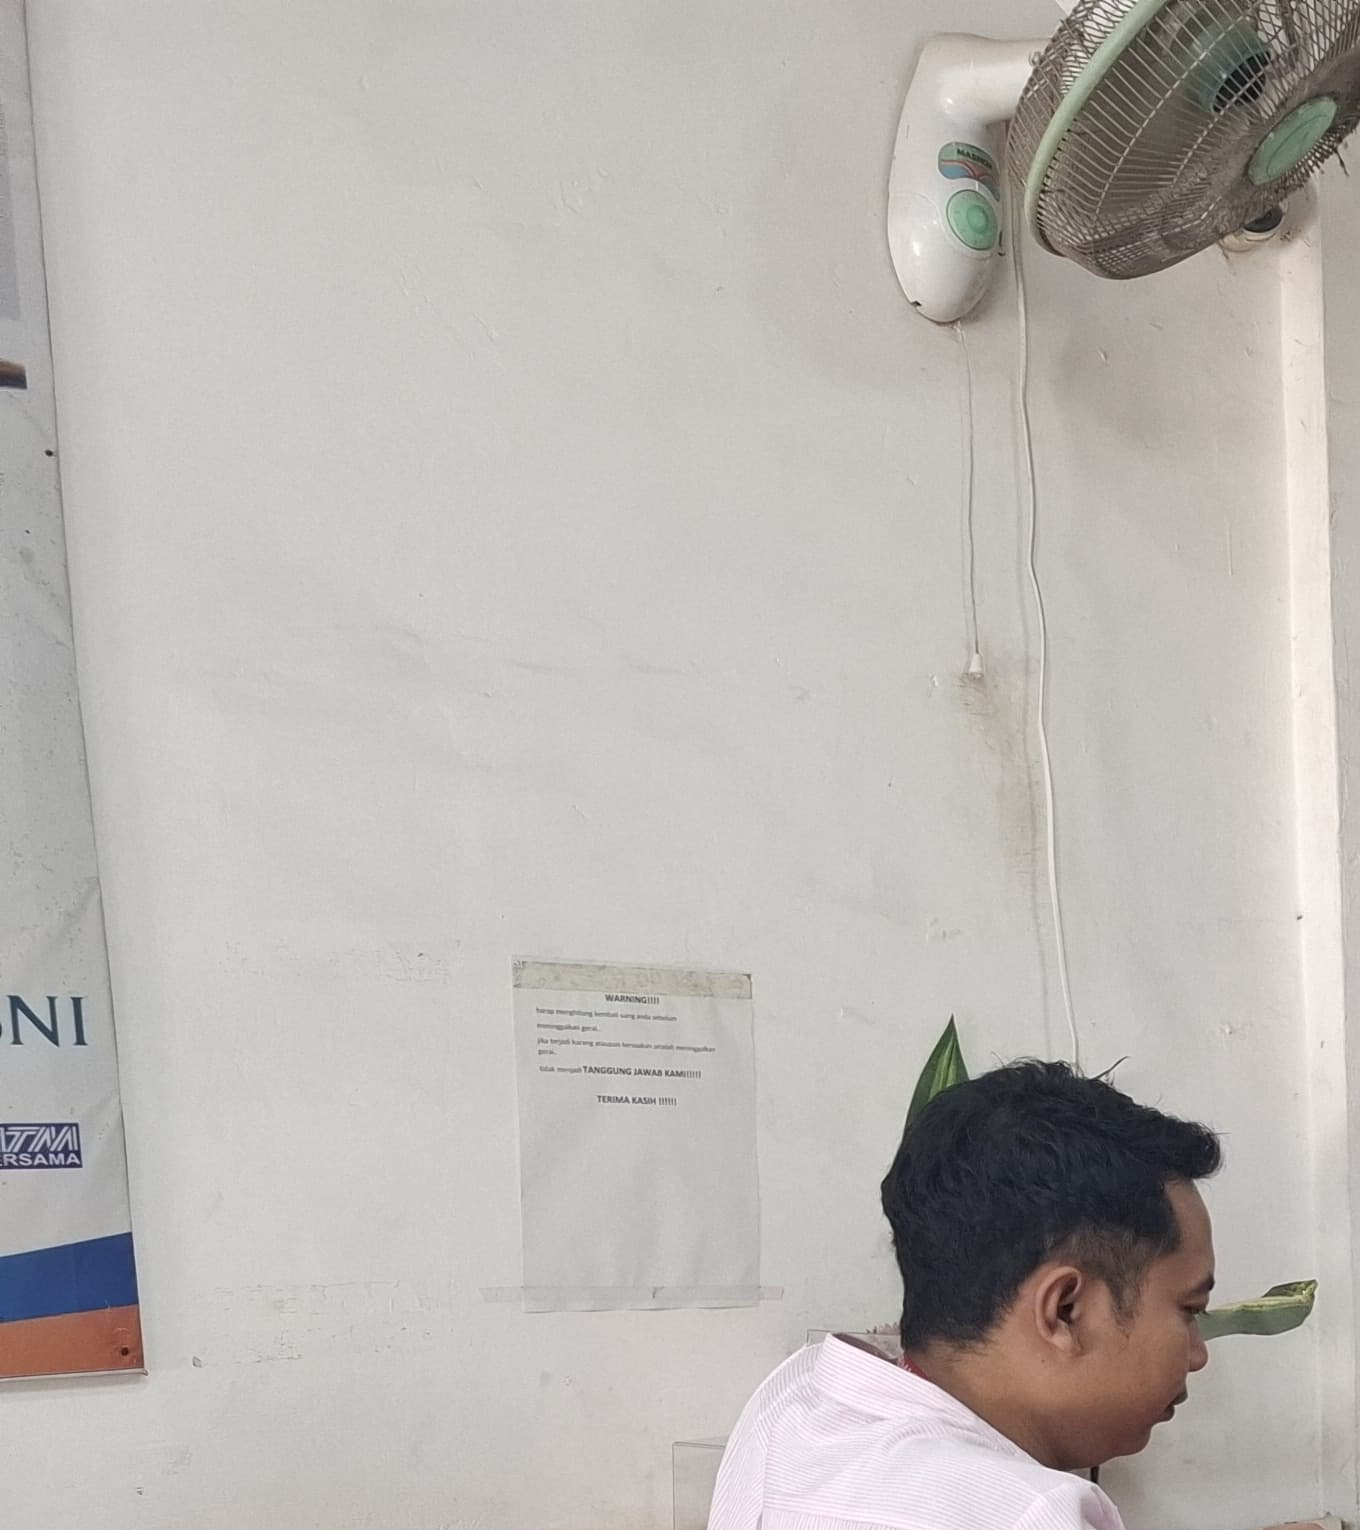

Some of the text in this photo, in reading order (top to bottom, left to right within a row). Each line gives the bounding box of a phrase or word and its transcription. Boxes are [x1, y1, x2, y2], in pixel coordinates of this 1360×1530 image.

[0, 995, 88, 1047] NI
[582, 1065, 663, 1077] TANGGUNG JAWAB
[596, 1095, 657, 1106] TERIMA KASIH
